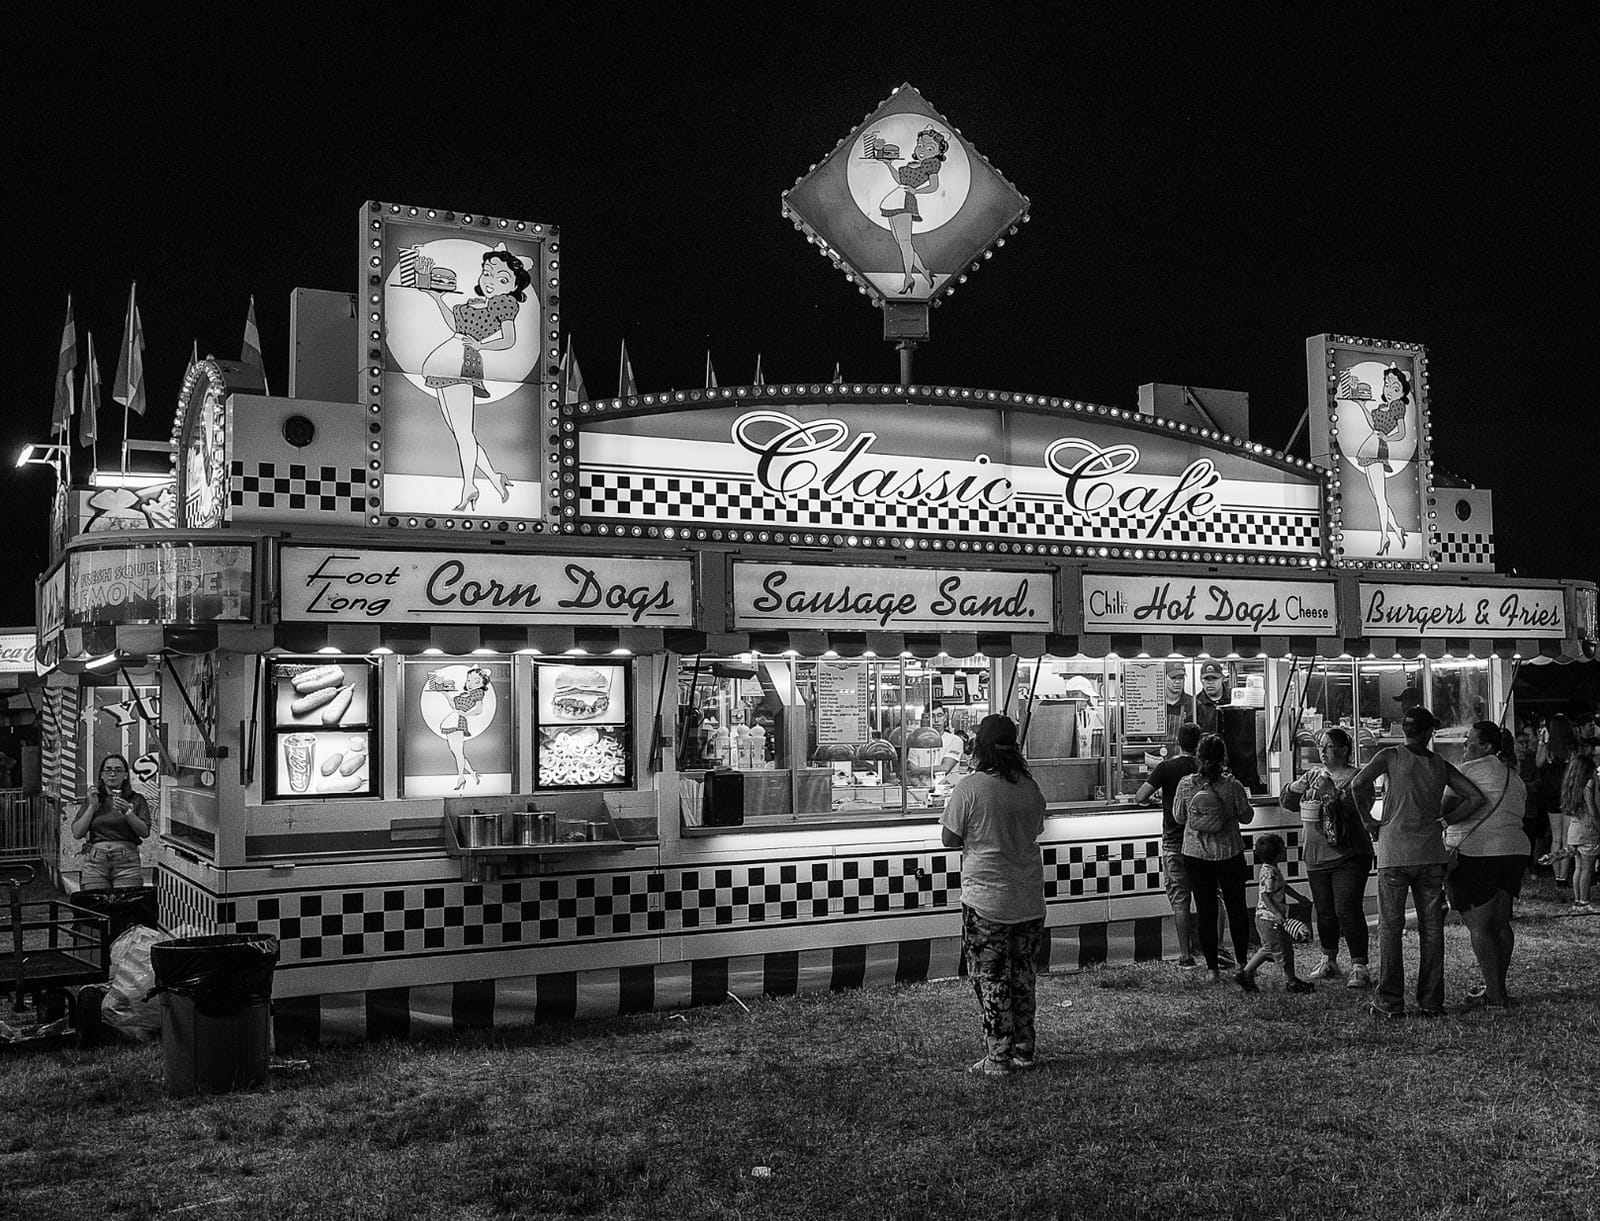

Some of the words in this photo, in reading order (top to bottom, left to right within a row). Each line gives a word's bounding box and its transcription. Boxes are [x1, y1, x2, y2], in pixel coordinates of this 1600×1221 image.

[731, 410, 1014, 505] Classic
[1044, 437, 1222, 539] Café
[80, 567, 113, 588] FRESH
[306, 555, 400, 588] Foot
[425, 559, 541, 608] Corn
[557, 563, 675, 624] Dogs
[306, 581, 391, 616] Long
[752, 569, 917, 628] Sausage
[930, 574, 1036, 618] Sand.
[1133, 582, 1197, 621] Hot
[1204, 584, 1281, 633] Dogs
[1285, 595, 1329, 621] Cheese
[1365, 588, 1467, 634] Burgers
[1474, 598, 1489, 626] &
[1499, 593, 1561, 628] Fries
